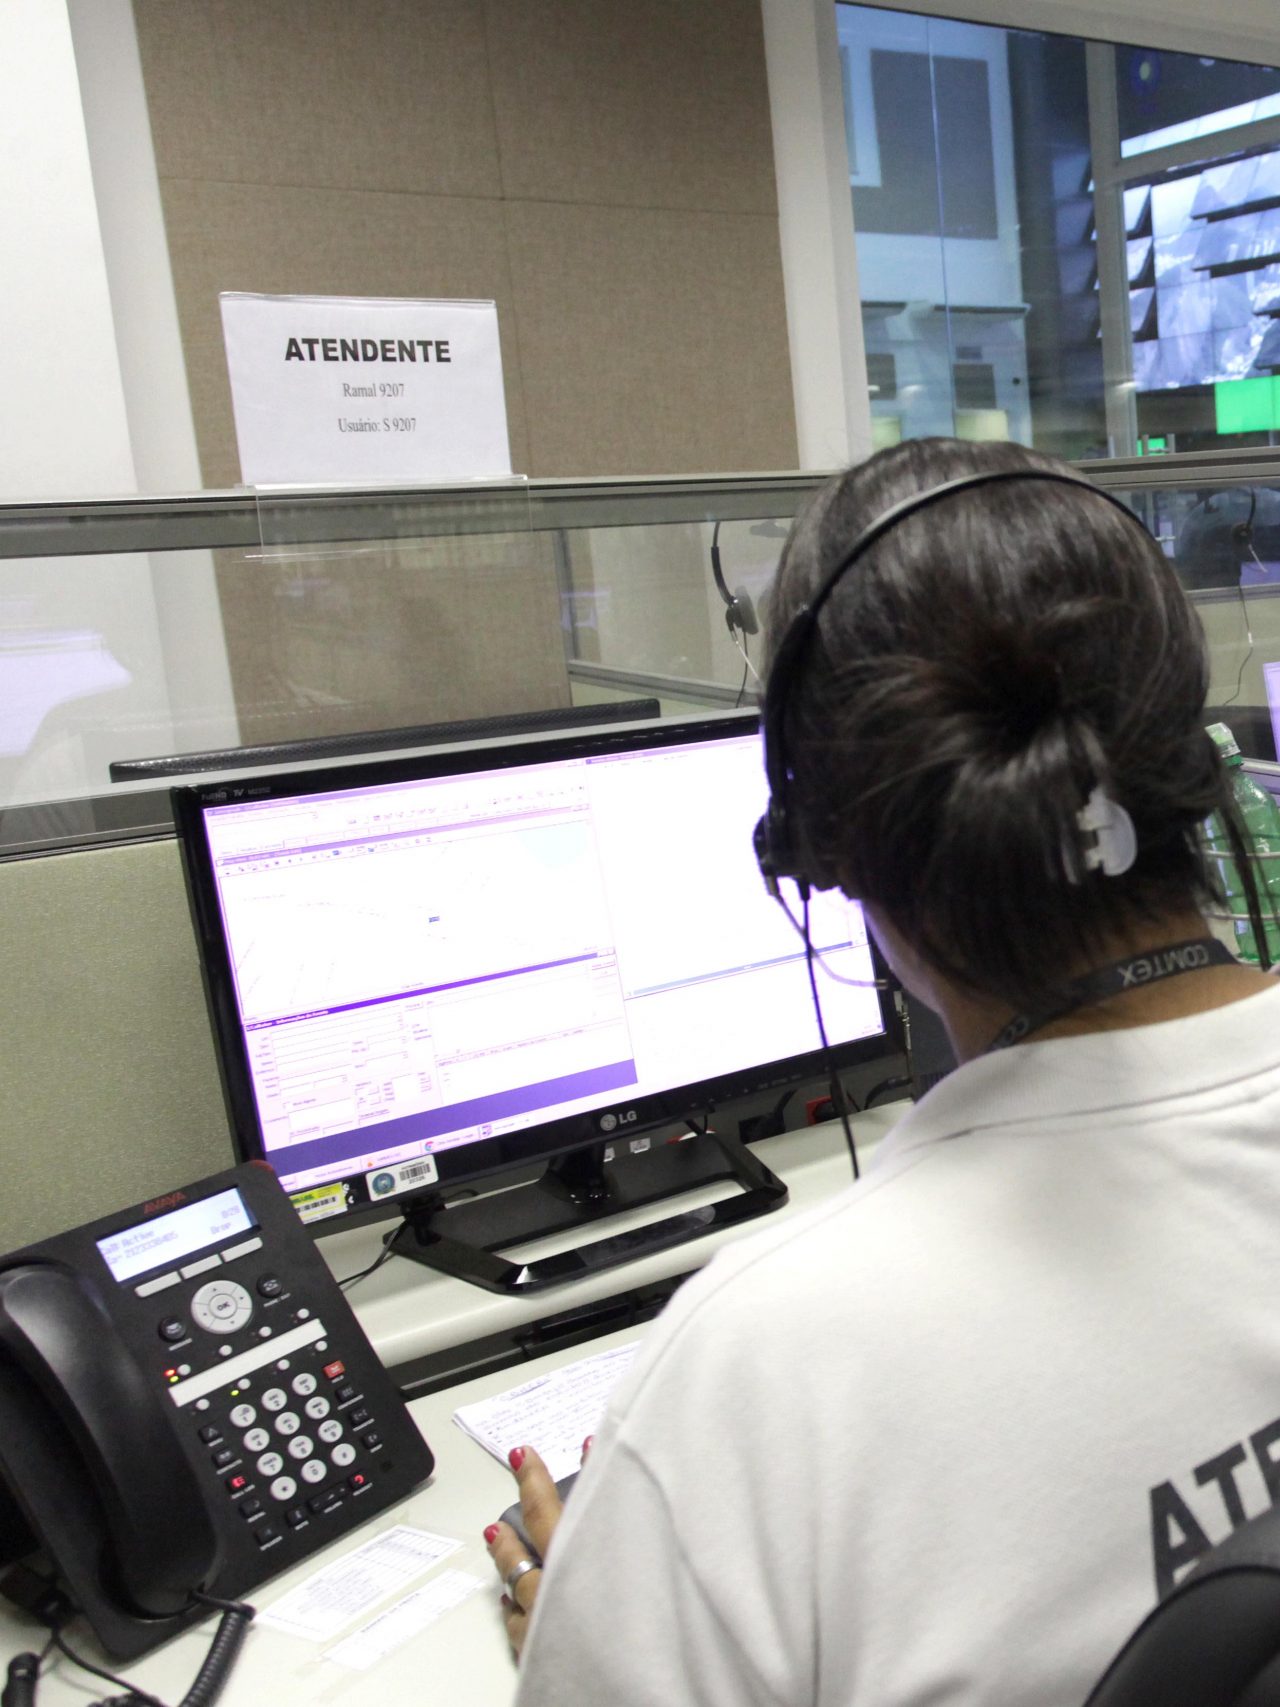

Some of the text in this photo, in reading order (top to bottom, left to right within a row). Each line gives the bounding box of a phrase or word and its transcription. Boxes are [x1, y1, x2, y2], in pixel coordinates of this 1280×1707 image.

[284, 337, 452, 363] ATENDENTE
[342, 382, 405, 398] Ramal 9207
[338, 417, 417, 433] Usuário: S 9207
[1116, 944, 1209, 986] COMTEX
[618, 1110, 638, 1125] LG
[144, 1192, 187, 1215] AVAYA
[217, 1301, 231, 1311] OK
